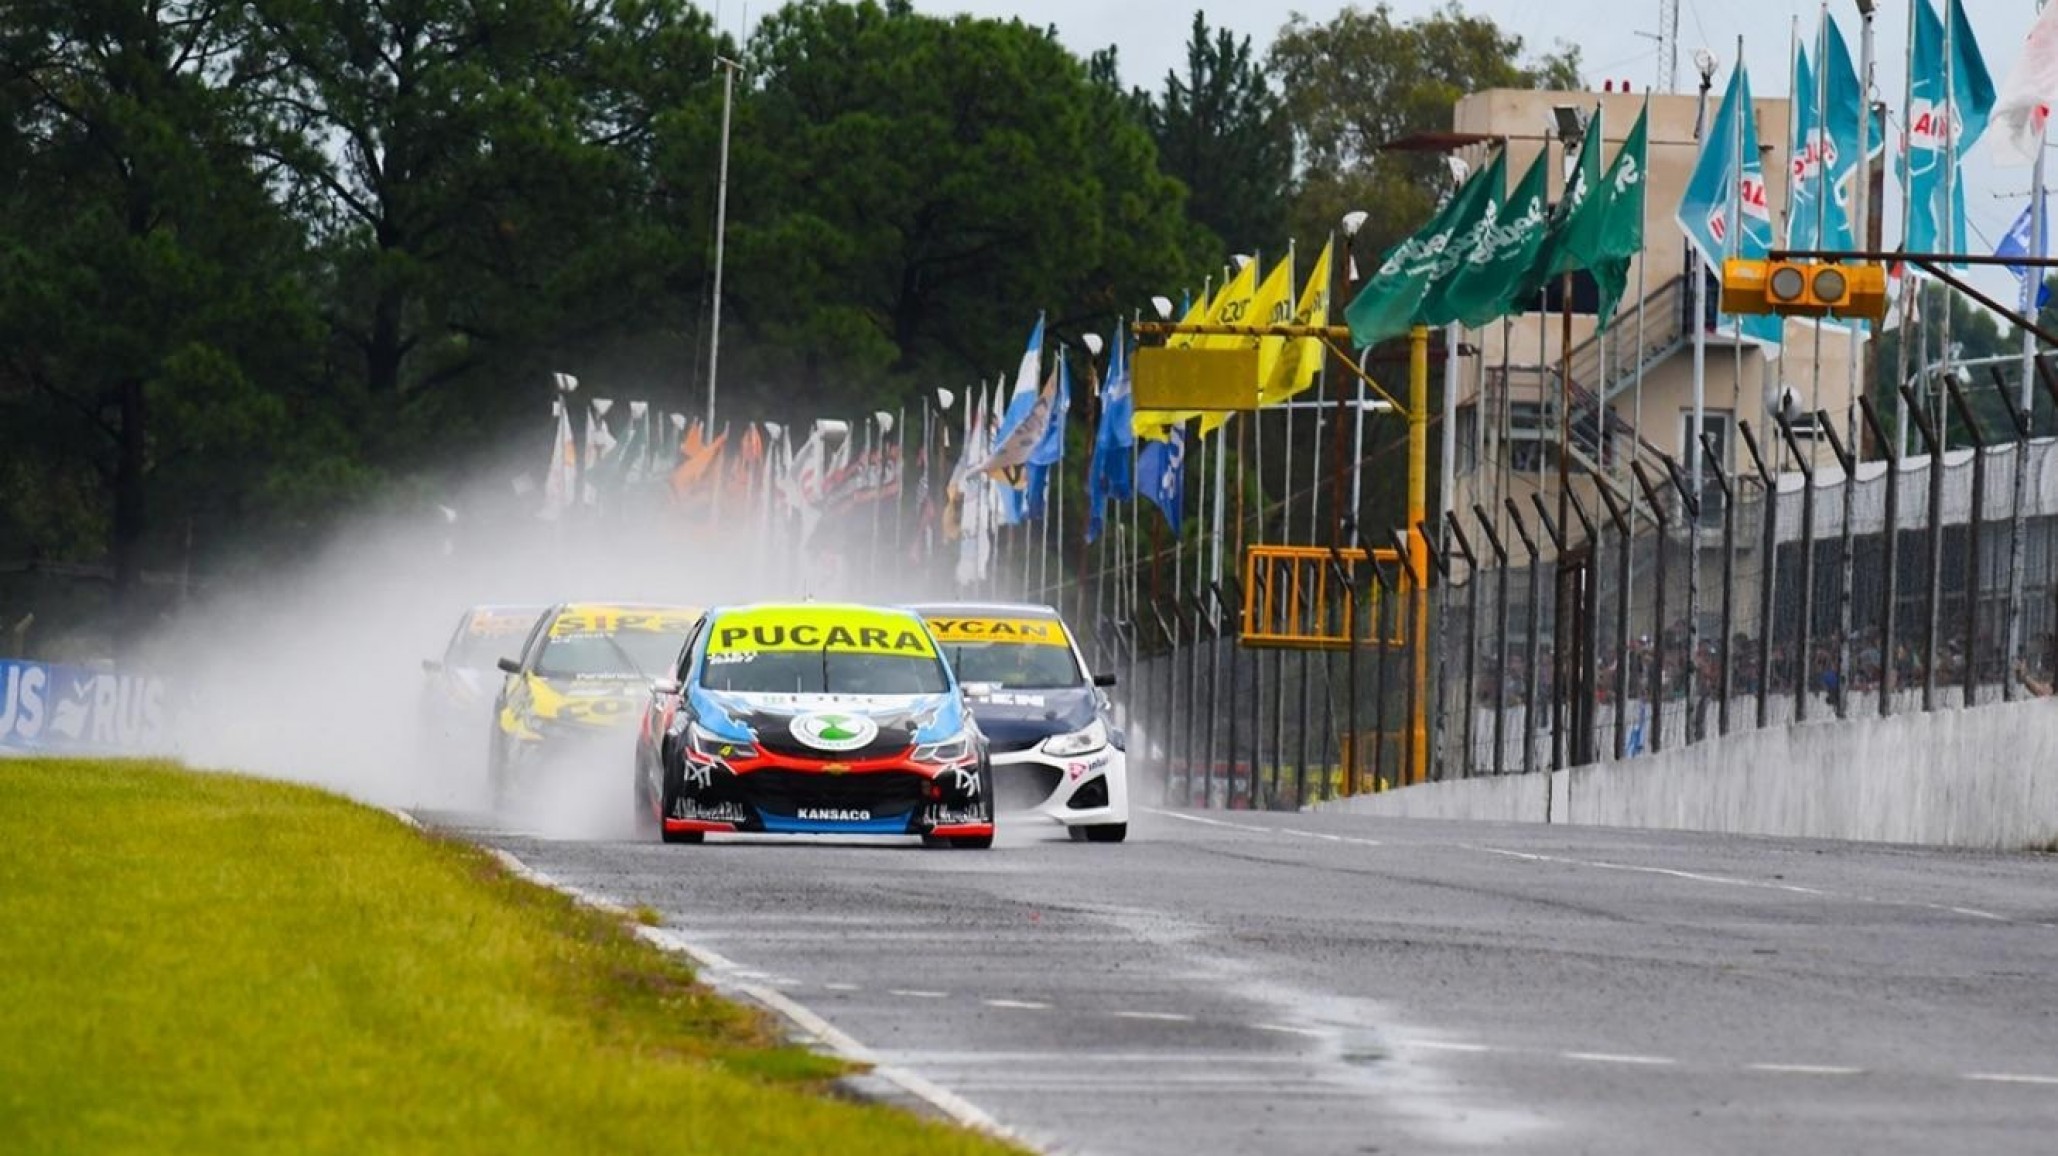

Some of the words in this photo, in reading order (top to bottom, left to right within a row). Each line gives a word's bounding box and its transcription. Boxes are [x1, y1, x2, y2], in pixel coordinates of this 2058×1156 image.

[721, 625, 925, 652] PUCARA
[929, 620, 1048, 636] YCAN
[92, 674, 165, 742] RUS
[798, 807, 871, 820] KANSACO
